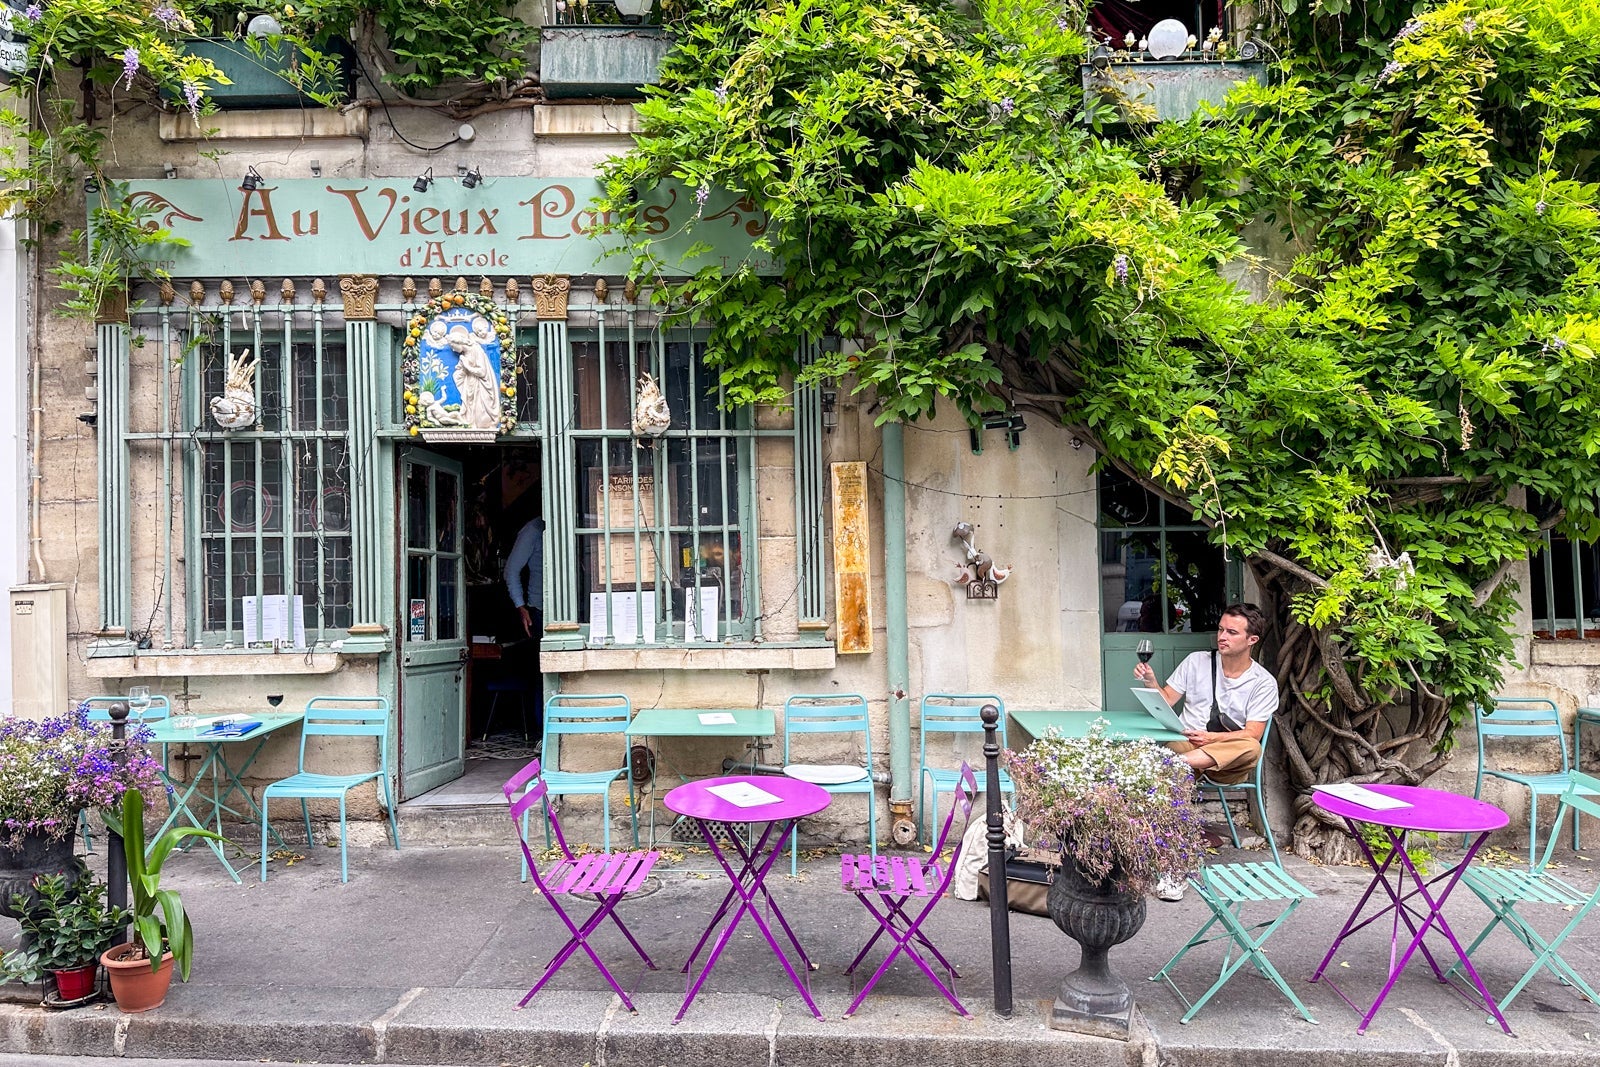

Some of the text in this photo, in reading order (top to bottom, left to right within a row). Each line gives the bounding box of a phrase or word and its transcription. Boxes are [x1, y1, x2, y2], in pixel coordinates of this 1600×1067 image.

[228, 185, 319, 242] Au
[325, 185, 499, 242] Vieux
[400, 240, 510, 269] d'Arcole
[753, 258, 768, 271] 40
[411, 625, 425, 633] 2022
